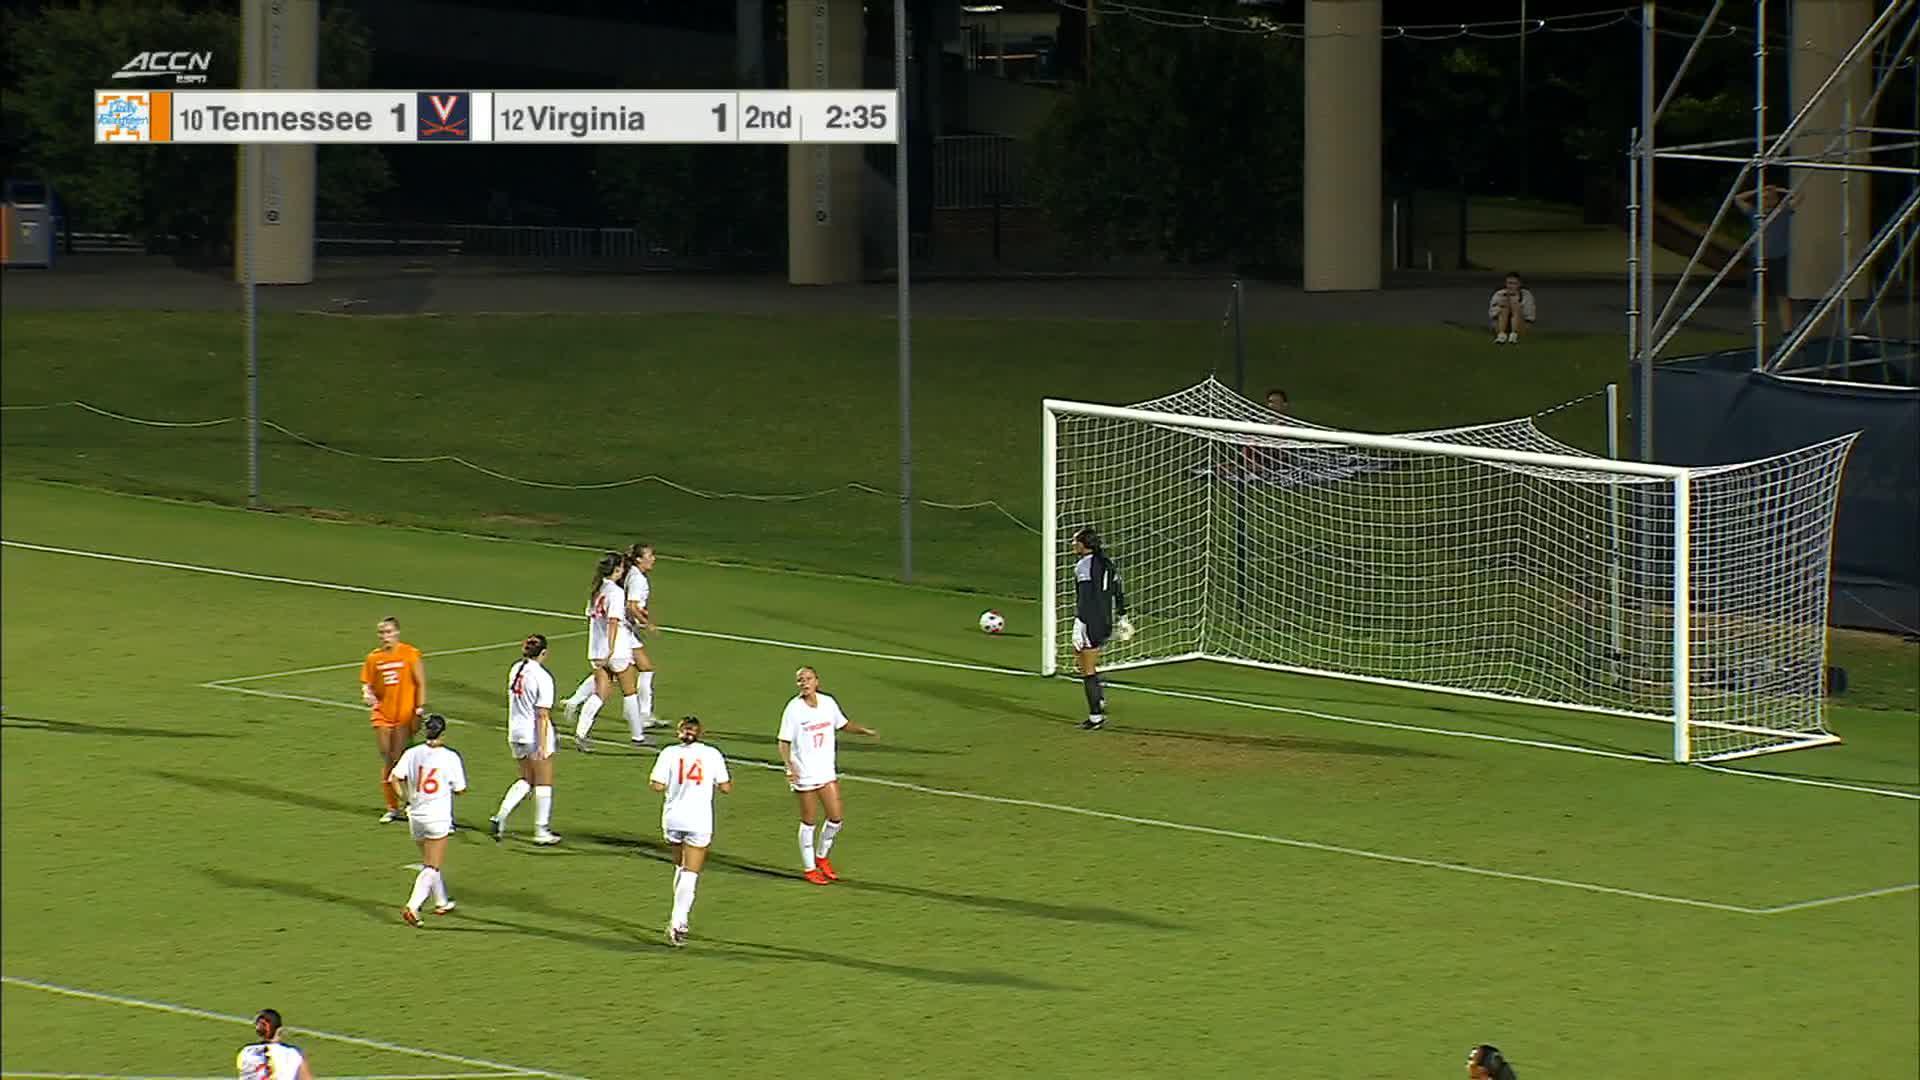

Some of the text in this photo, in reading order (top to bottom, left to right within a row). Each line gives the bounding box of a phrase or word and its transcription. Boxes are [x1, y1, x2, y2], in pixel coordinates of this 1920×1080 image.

[813, 732, 825, 749] 17
[416, 766, 440, 794] 16
[678, 757, 704, 785] 14
